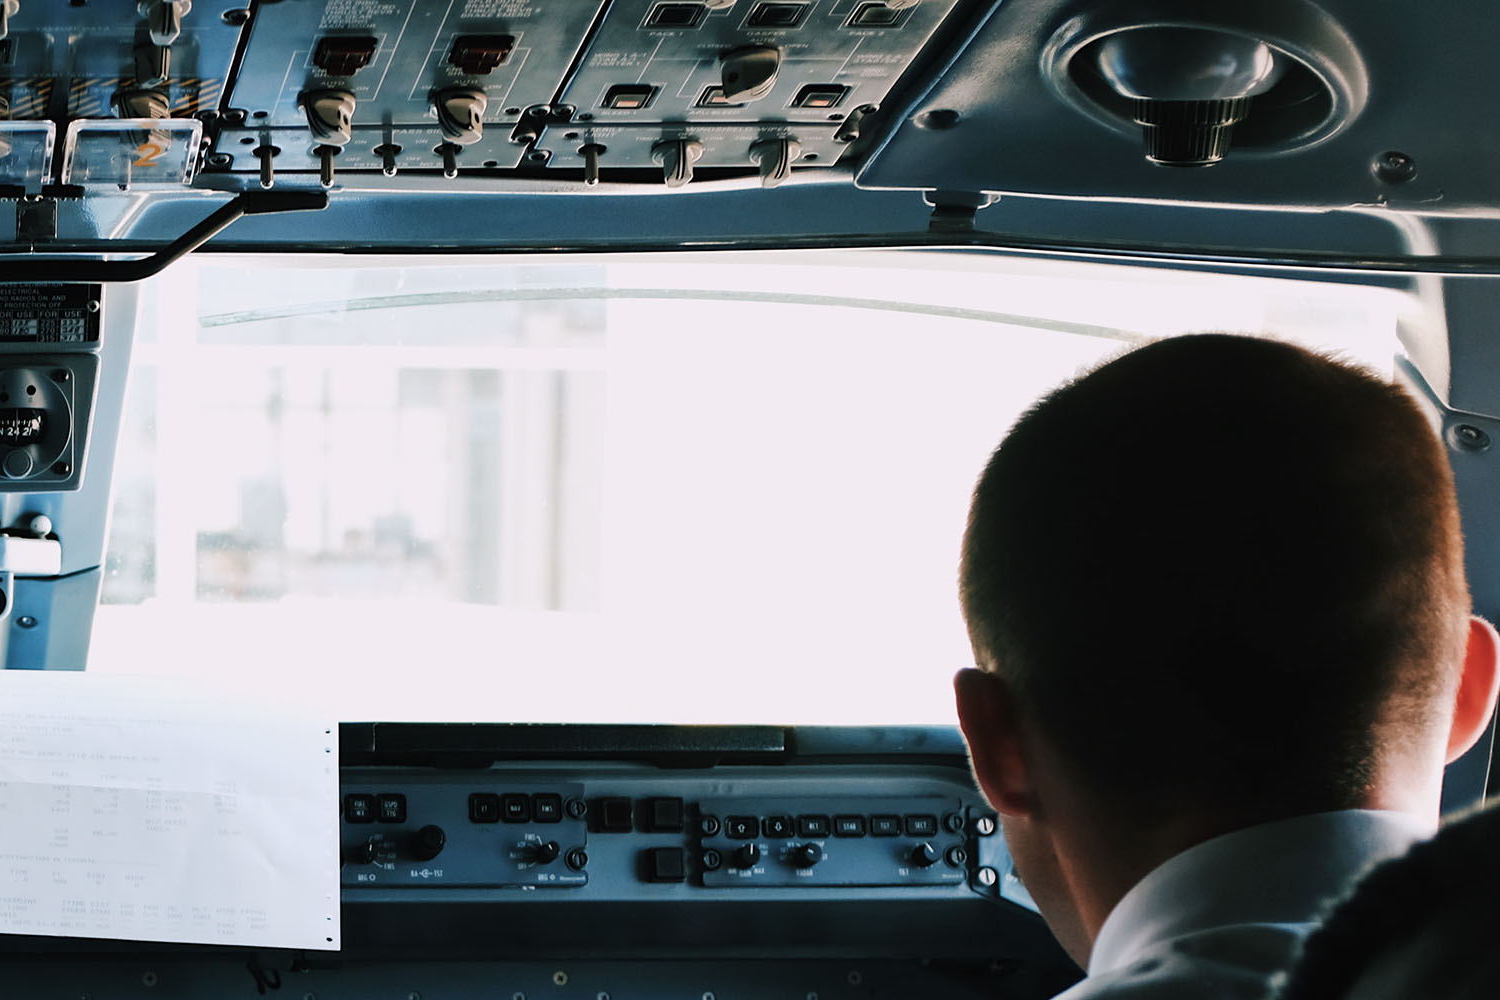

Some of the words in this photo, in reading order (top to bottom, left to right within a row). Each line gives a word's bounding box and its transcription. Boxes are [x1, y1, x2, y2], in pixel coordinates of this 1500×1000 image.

[452, 78, 479, 86] AUTO
[132, 143, 161, 167] 2
[0, 288, 41, 296] ELECTRICAL
[16, 310, 35, 319] USE
[39, 310, 58, 319] FOR
[63, 310, 82, 318] USE
[6, 426, 20, 437] 24
[843, 822, 857, 831] STAB
[913, 821, 927, 830] SECT
